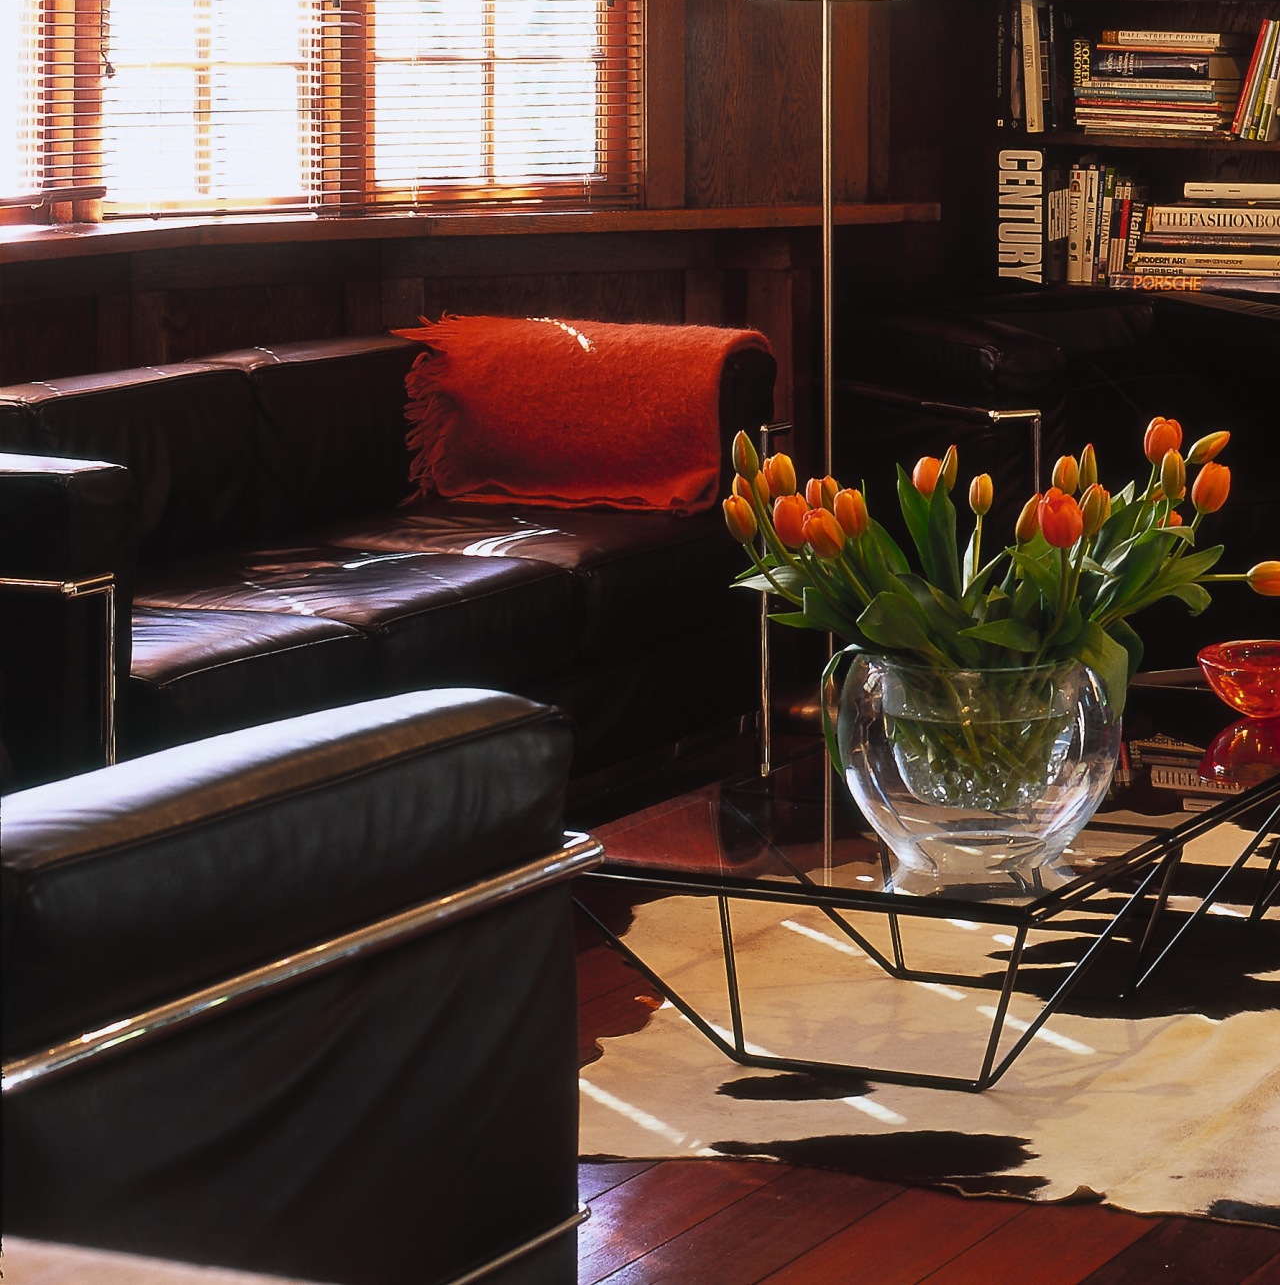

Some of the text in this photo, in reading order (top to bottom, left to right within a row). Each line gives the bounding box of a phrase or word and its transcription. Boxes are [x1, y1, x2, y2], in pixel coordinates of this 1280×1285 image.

[1120, 31, 1140, 39] WALL
[1144, 32, 1174, 40] STREET
[1175, 32, 1205, 41] PEOPLE
[1072, 42, 1082, 84] OXFORD
[1081, 43, 1091, 83] POCKET
[998, 150, 1043, 284] CENTURY
[1068, 195, 1082, 233] ITALY
[1085, 206, 1096, 229] ROME
[1099, 210, 1111, 246] ITALIAN
[1127, 211, 1143, 257] Italian
[1137, 256, 1170, 266] MODERN
[1171, 256, 1187, 266] ART
[1142, 267, 1184, 275] PORSCHE
[1132, 275, 1202, 292] PORSCHE
